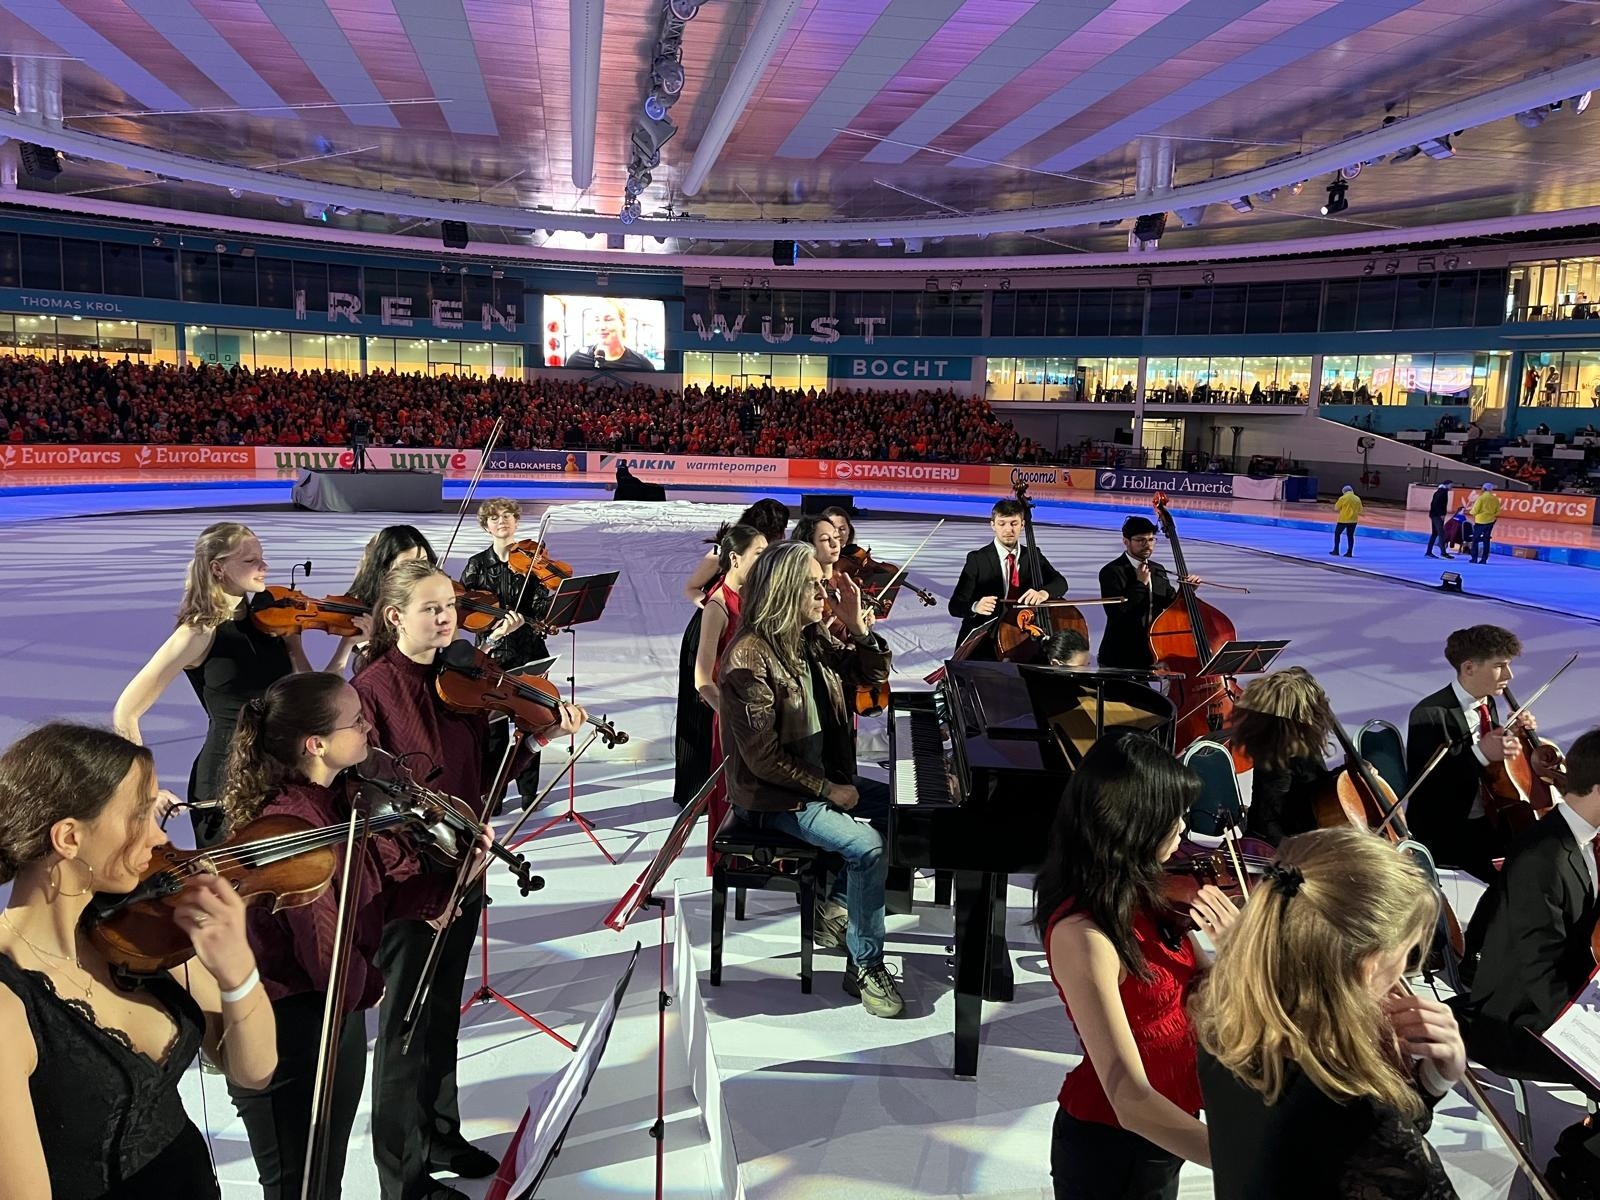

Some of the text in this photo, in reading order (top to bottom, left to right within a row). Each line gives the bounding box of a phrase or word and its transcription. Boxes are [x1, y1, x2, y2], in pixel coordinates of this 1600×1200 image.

[20, 295, 123, 312] THOMAS KROL
[295, 289, 887, 345] IREEN WÜST
[852, 359, 949, 377] BOCHT
[20, 447, 122, 464] EuroParcs
[155, 447, 249, 464] EuroParcs
[508, 462, 562, 470] BADKAMERS
[685, 460, 777, 474] warmtepompen
[852, 464, 961, 481] STAATSLOTERIJ
[1010, 467, 1057, 485] Chocomel
[1122, 475, 1176, 491] Holland
[1493, 493, 1588, 517] uroParcs
